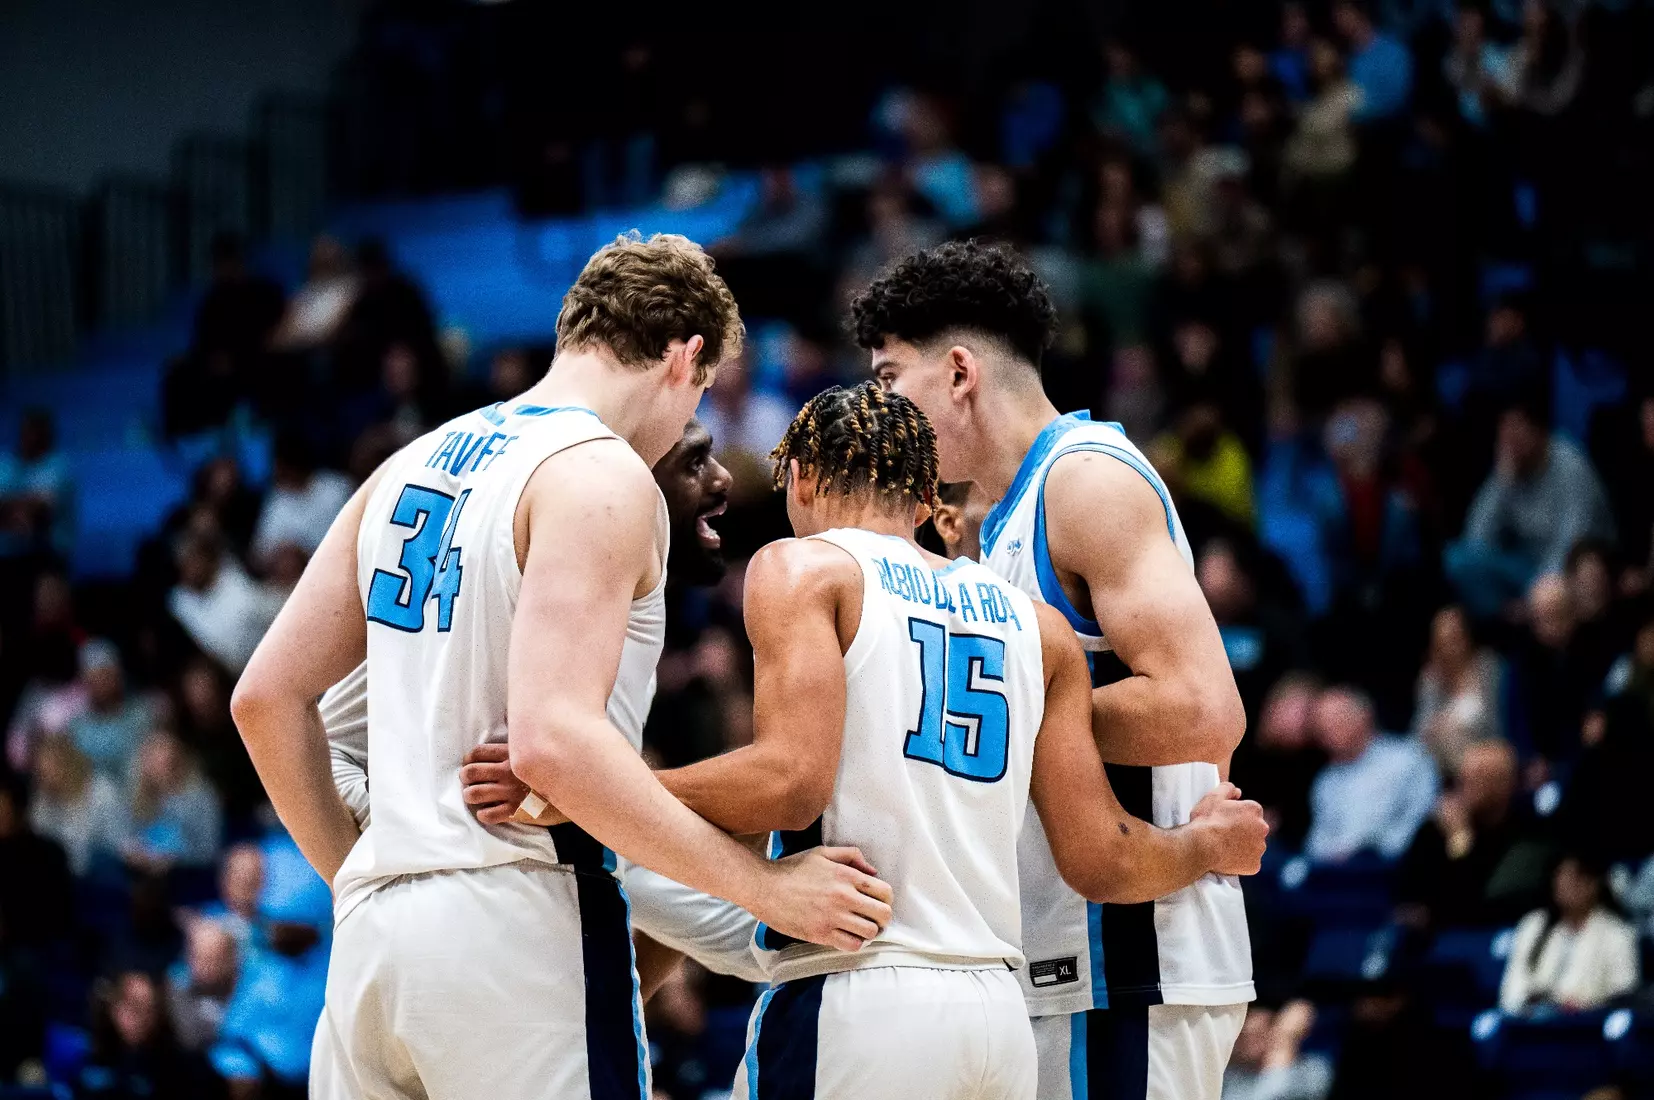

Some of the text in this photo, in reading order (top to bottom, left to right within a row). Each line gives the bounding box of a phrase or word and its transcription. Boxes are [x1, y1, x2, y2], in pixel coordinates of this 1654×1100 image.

[367, 483, 473, 633] 34
[903, 616, 1010, 783] 15
[1059, 965, 1072, 976] XL
